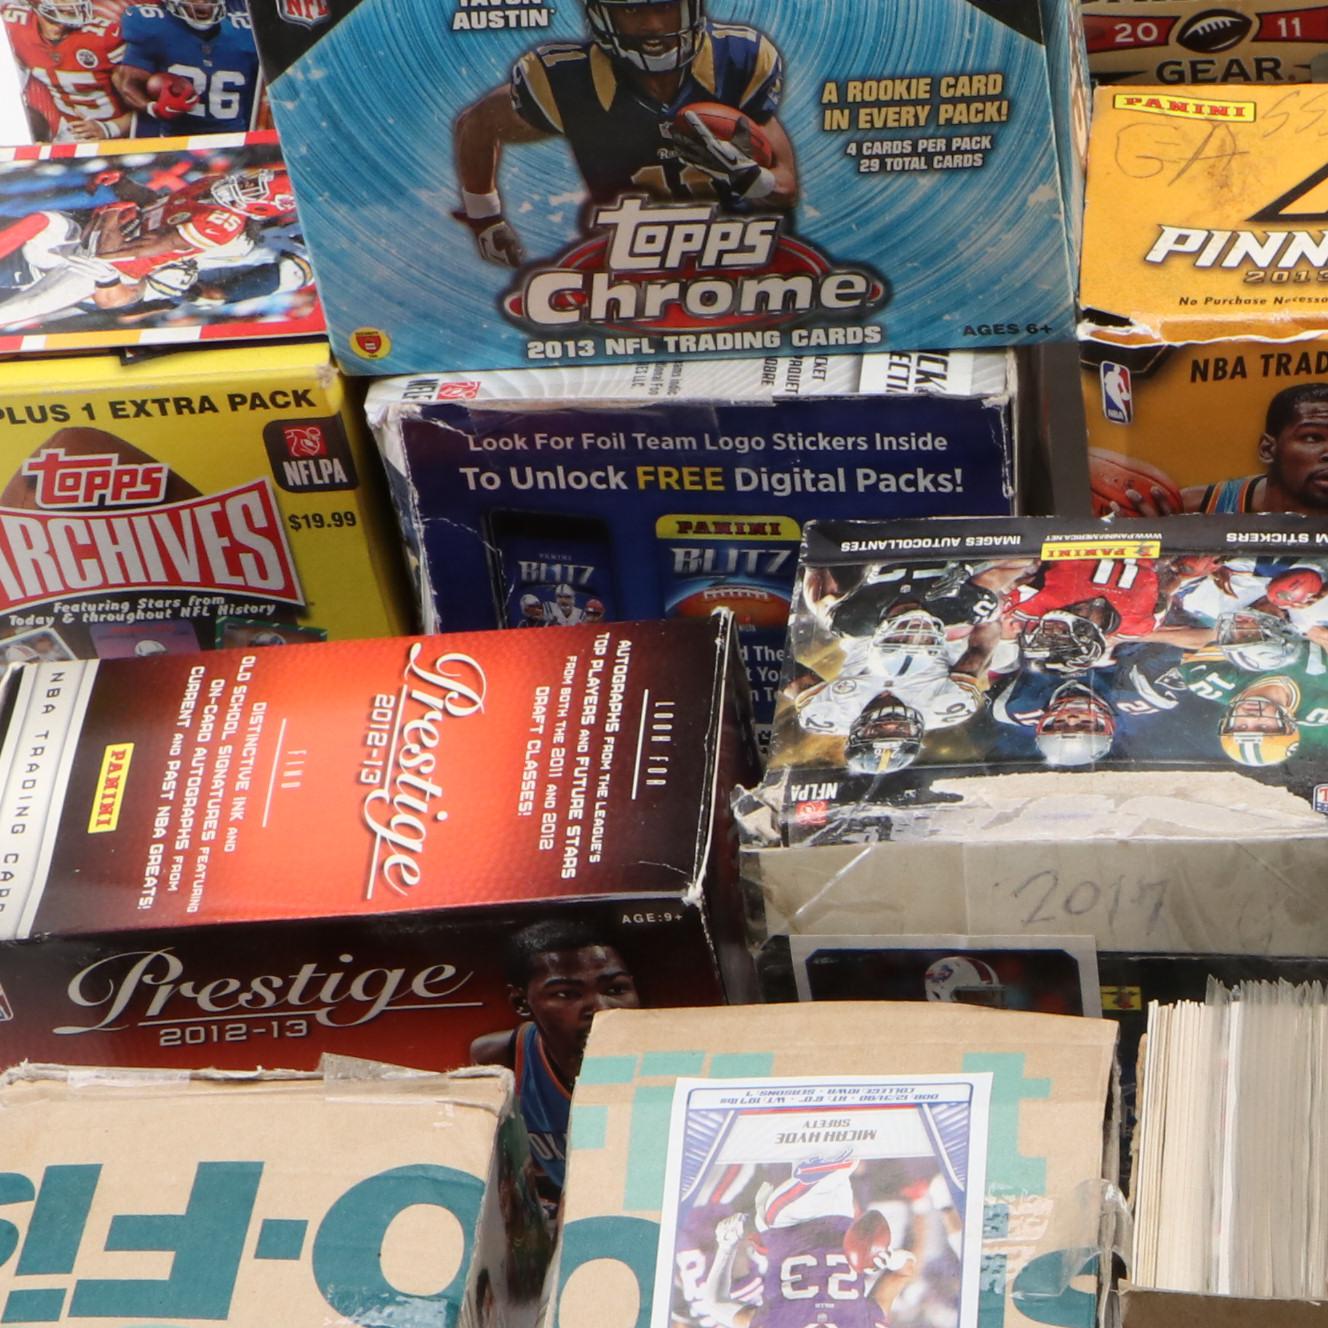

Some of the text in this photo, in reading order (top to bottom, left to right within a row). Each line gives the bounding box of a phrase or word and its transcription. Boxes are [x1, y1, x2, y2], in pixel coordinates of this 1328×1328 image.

[452, 9, 549, 30] AUSTIN
[1113, 22, 1159, 43] 20
[1277, 17, 1302, 38] 11
[1156, 57, 1284, 84] GEAR
[822, 73, 1003, 103] A ROOKIE CARD
[823, 100, 1009, 131] IN EVERY PACK!
[1122, 97, 1247, 118] PANINI
[847, 135, 993, 156] 4 CARDS PER PACK
[859, 153, 983, 173] 29 TOTAL CARDS
[525, 271, 869, 326] Chrome
[1178, 296, 1199, 306] No
[1203, 295, 1267, 306] Purchase
[962, 321, 1053, 336] AGES 6+
[526, 326, 882, 359] 2013 NFL TRADING CARDS
[1190, 356, 1248, 384] NBA
[81, 403, 96, 421] 1
[108, 396, 219, 420] EXTRA
[229, 389, 317, 413] PACK
[468, 430, 948, 456] Look For Foil Team Logo Stickers Inside
[282, 458, 348, 487] NFLPA
[460, 465, 964, 498] To Unlock FREE Digital Packs!
[288, 511, 357, 532] $19.99
[675, 520, 783, 537] PANINI
[840, 534, 1021, 552] IMAGES AUTOCOLLANTES
[1226, 532, 1311, 545] STICKERS
[9, 614, 55, 628] Today
[81, 609, 177, 625] throughout
[180, 606, 211, 618] NFL
[217, 602, 276, 616] History
[53, 595, 226, 616] Featuring Stars from
[360, 693, 396, 785] 2012-13
[517, 685, 551, 817] DRAFT CLASSES!
[588, 639, 632, 864] AUTOGRAPHS FROM THE LEAGUE'S
[11, 671, 67, 836] NBA TRADING
[560, 631, 610, 880] TOP PLAYERS AND FUTURE STARS
[364, 642, 488, 897] Prestige
[136, 666, 206, 911] CURRENT AND PAST NBA GREATS!
[186, 655, 257, 913] OLD SCHOOL SIGNATURES FEATURING
[790, 781, 838, 802] NFLPA
[622, 911, 684, 926] AGE:9+
[53, 946, 475, 1037] Prestige
[159, 1020, 309, 1047] 2012-13
[774, 1129, 878, 1146] MICAH HYDE
